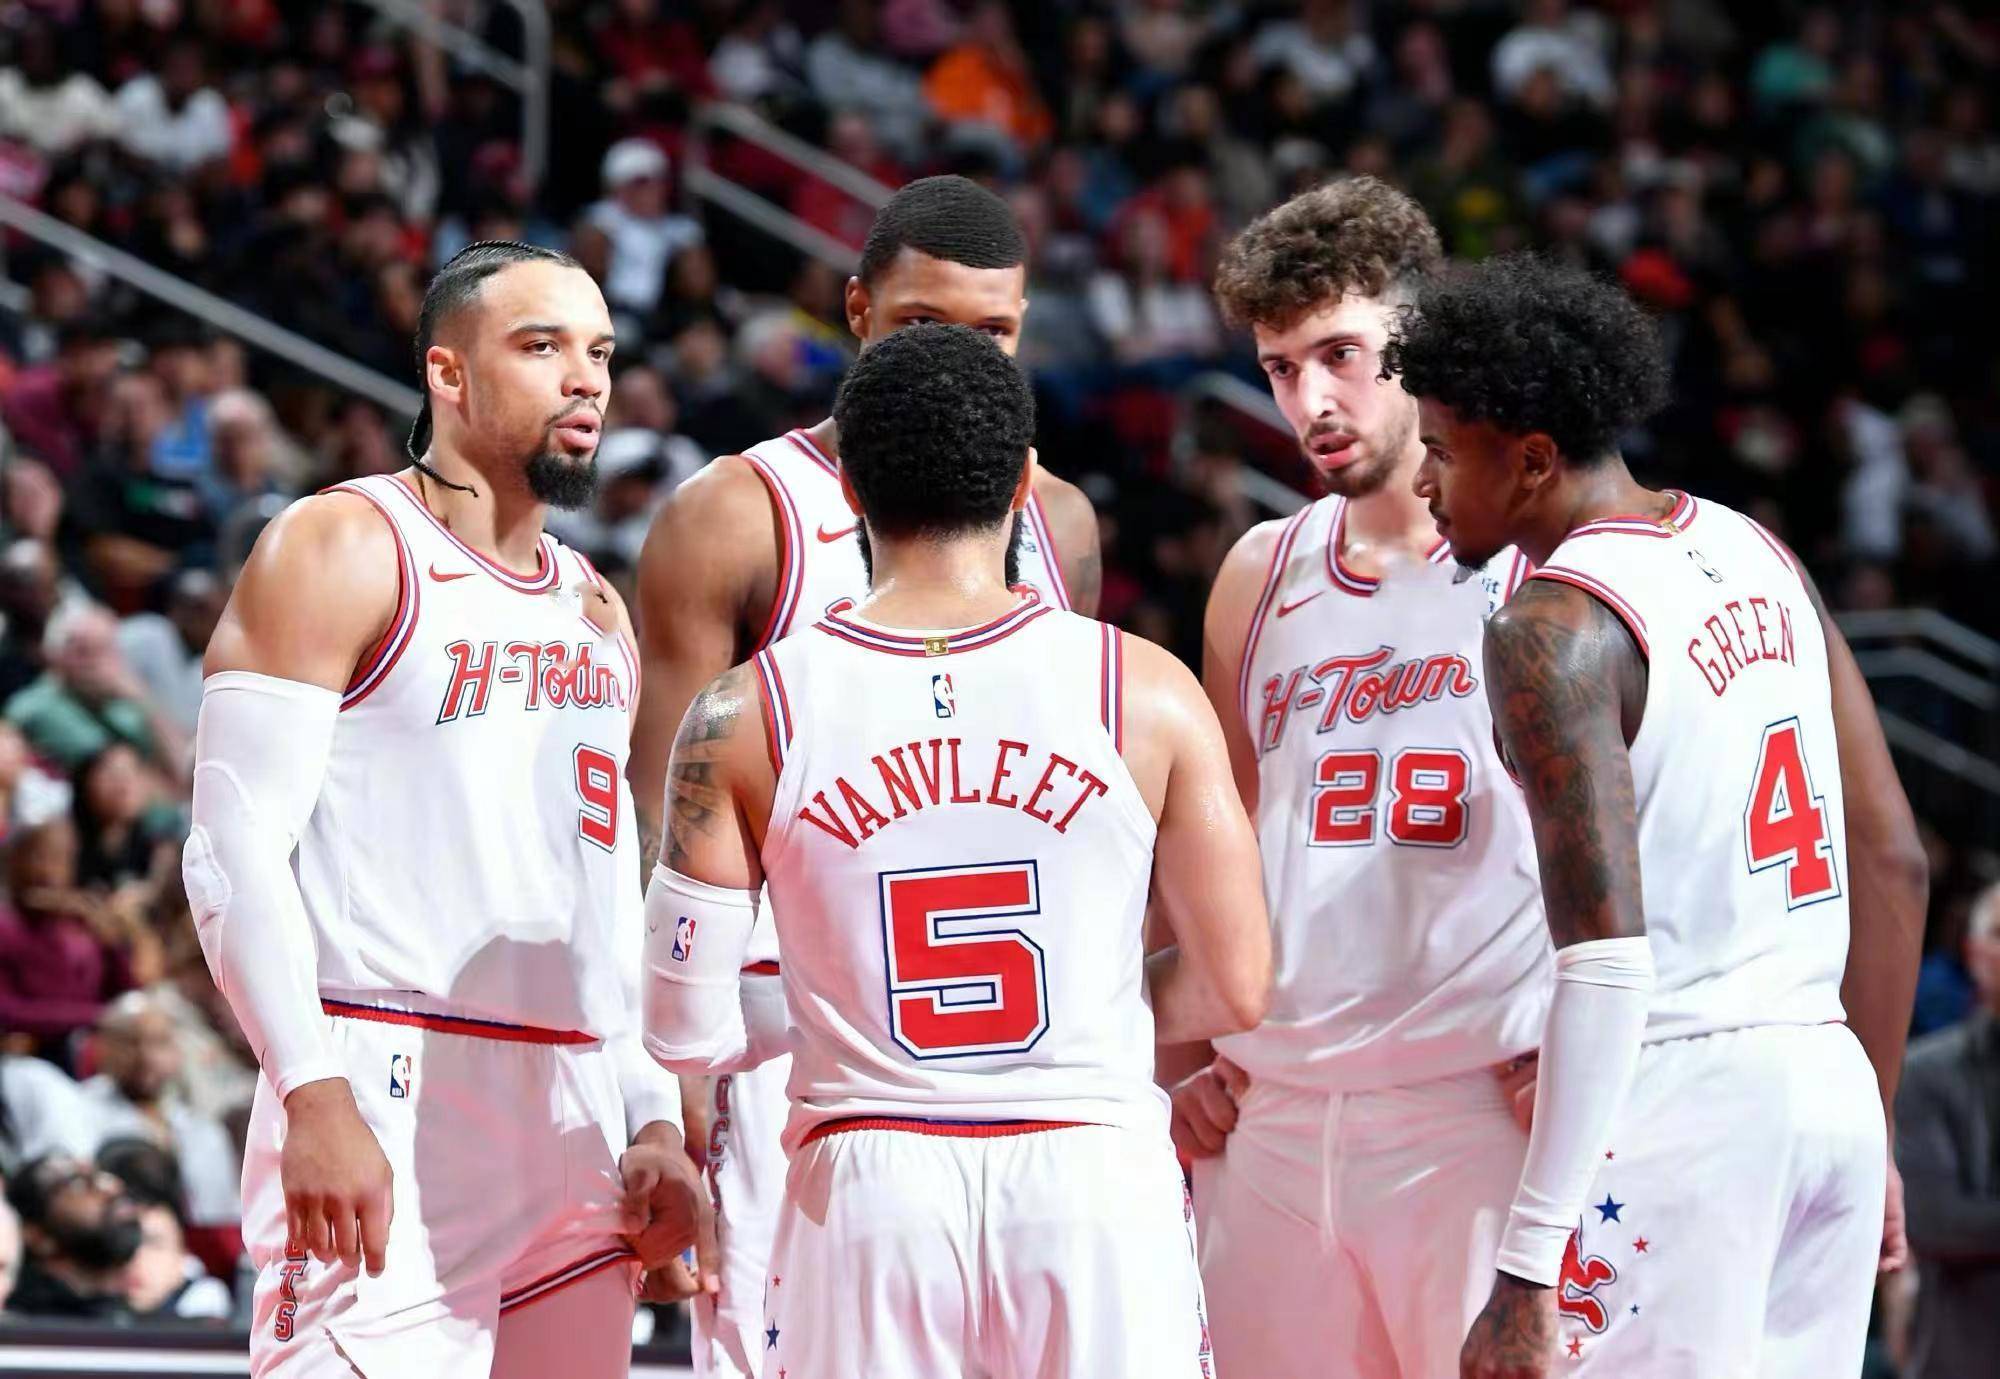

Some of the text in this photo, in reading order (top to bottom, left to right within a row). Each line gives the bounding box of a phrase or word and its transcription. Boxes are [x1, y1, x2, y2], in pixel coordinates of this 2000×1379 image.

[1260, 645, 1478, 753] H-Town
[1688, 597, 1796, 697] GREEN
[573, 743, 620, 854] 9
[799, 738, 1109, 850] VANVLEET
[1307, 747, 1471, 849] 28
[1743, 715, 1841, 912] 4
[878, 859, 1050, 1061] 5
